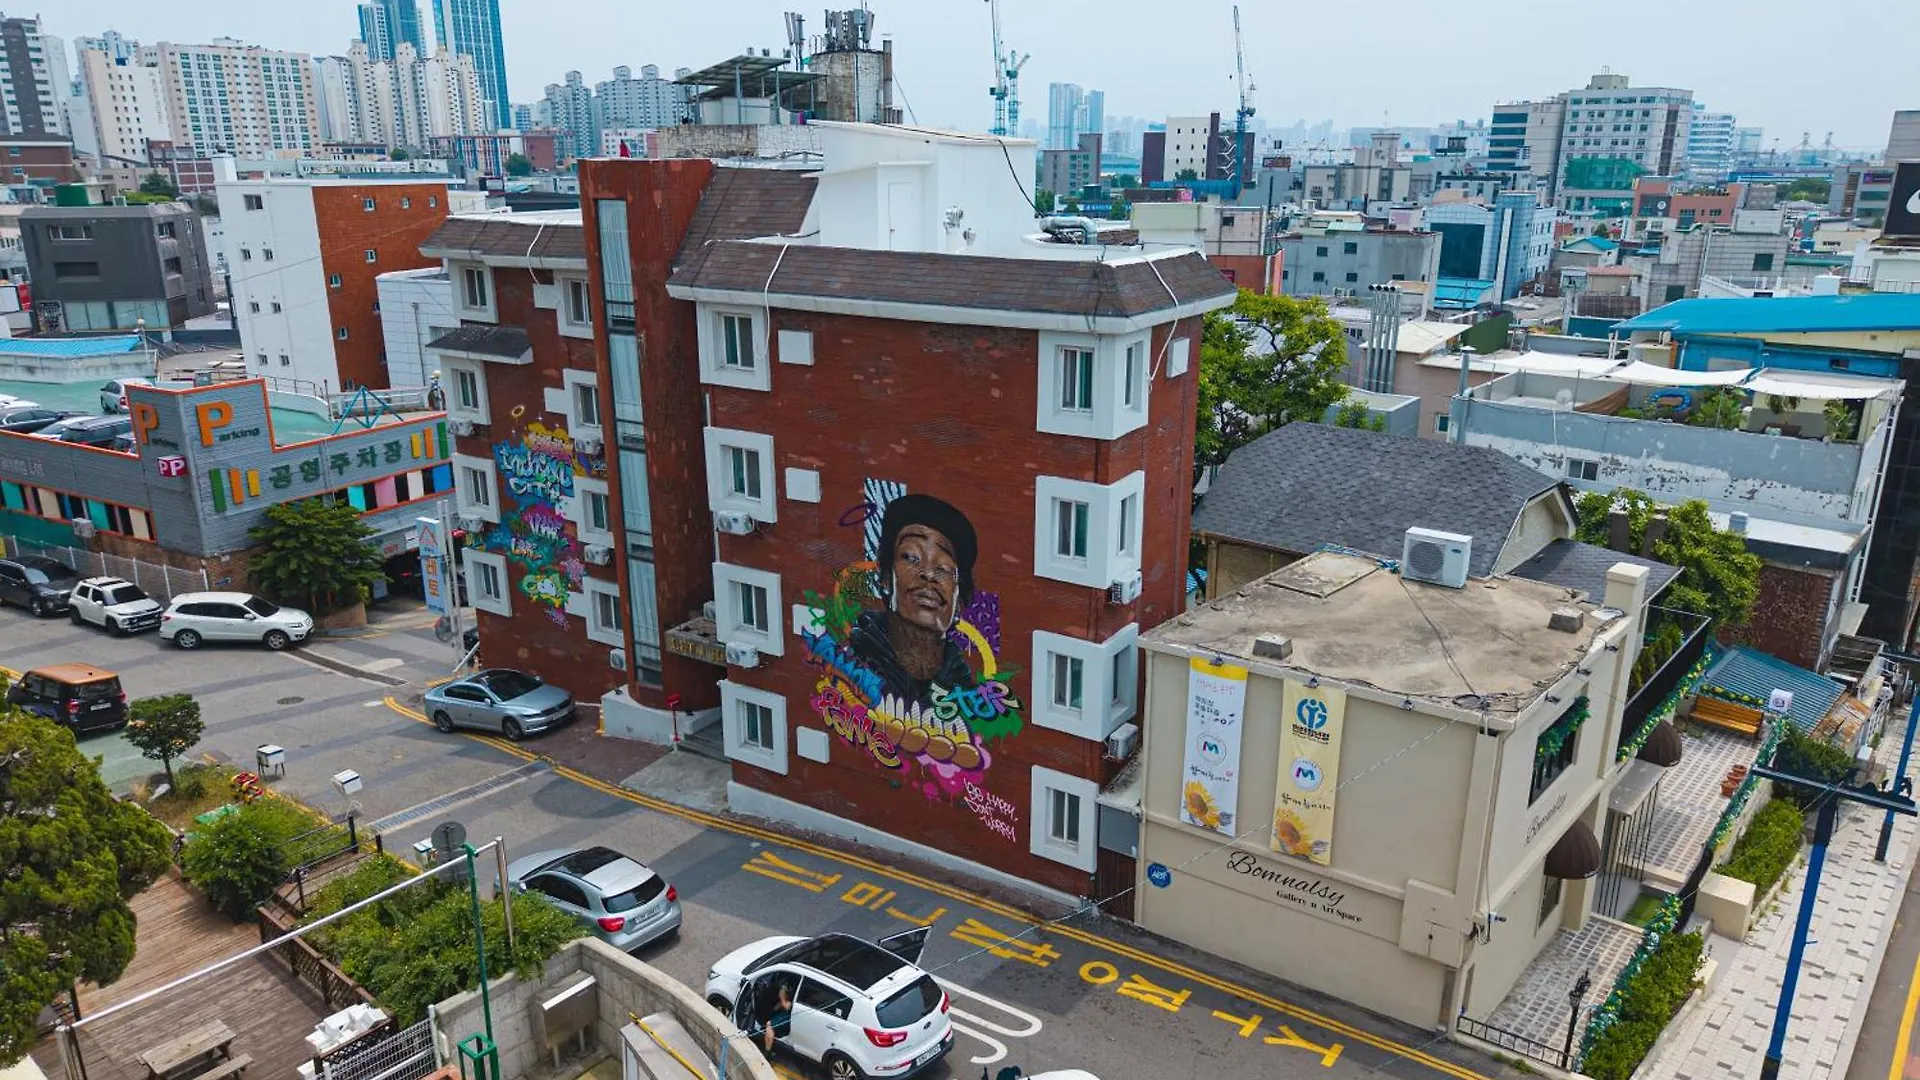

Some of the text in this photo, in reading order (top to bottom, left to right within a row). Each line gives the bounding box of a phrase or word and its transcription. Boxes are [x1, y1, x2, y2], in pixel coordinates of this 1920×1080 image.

[169, 459, 185, 476] P
[268, 440, 403, 489] 공영주차장
[1227, 851, 1345, 907] Bomnalsy
[1276, 890, 1306, 906] Gallery
